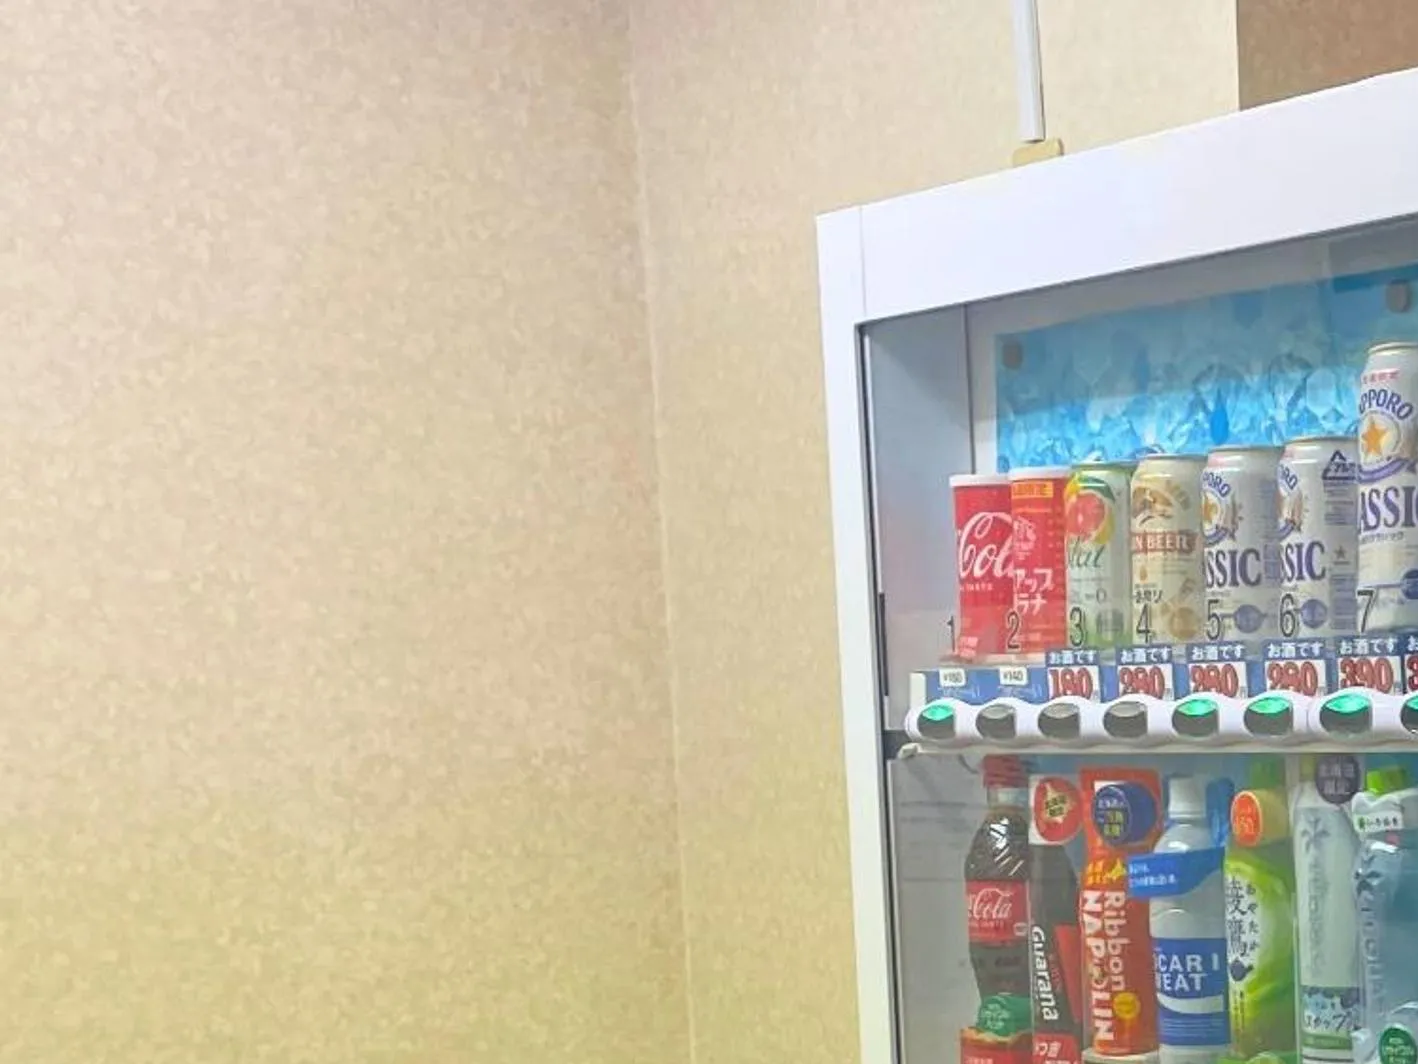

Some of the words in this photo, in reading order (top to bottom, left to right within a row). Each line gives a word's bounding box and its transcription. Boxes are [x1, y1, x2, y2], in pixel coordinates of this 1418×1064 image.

[1007, 610, 1020, 649] 2
[1069, 607, 1083, 647] 3
[1136, 604, 1151, 644] 4
[1206, 599, 1221, 640] 5
[1279, 594, 1297, 638] 6
[1357, 590, 1374, 633] 7
[947, 616, 956, 652] 1
[1268, 641, 1323, 658] お酒です
[1339, 637, 1398, 654] お酒です
[1105, 890, 1128, 994] Ribbon
[1031, 924, 1060, 1022] Guarana
